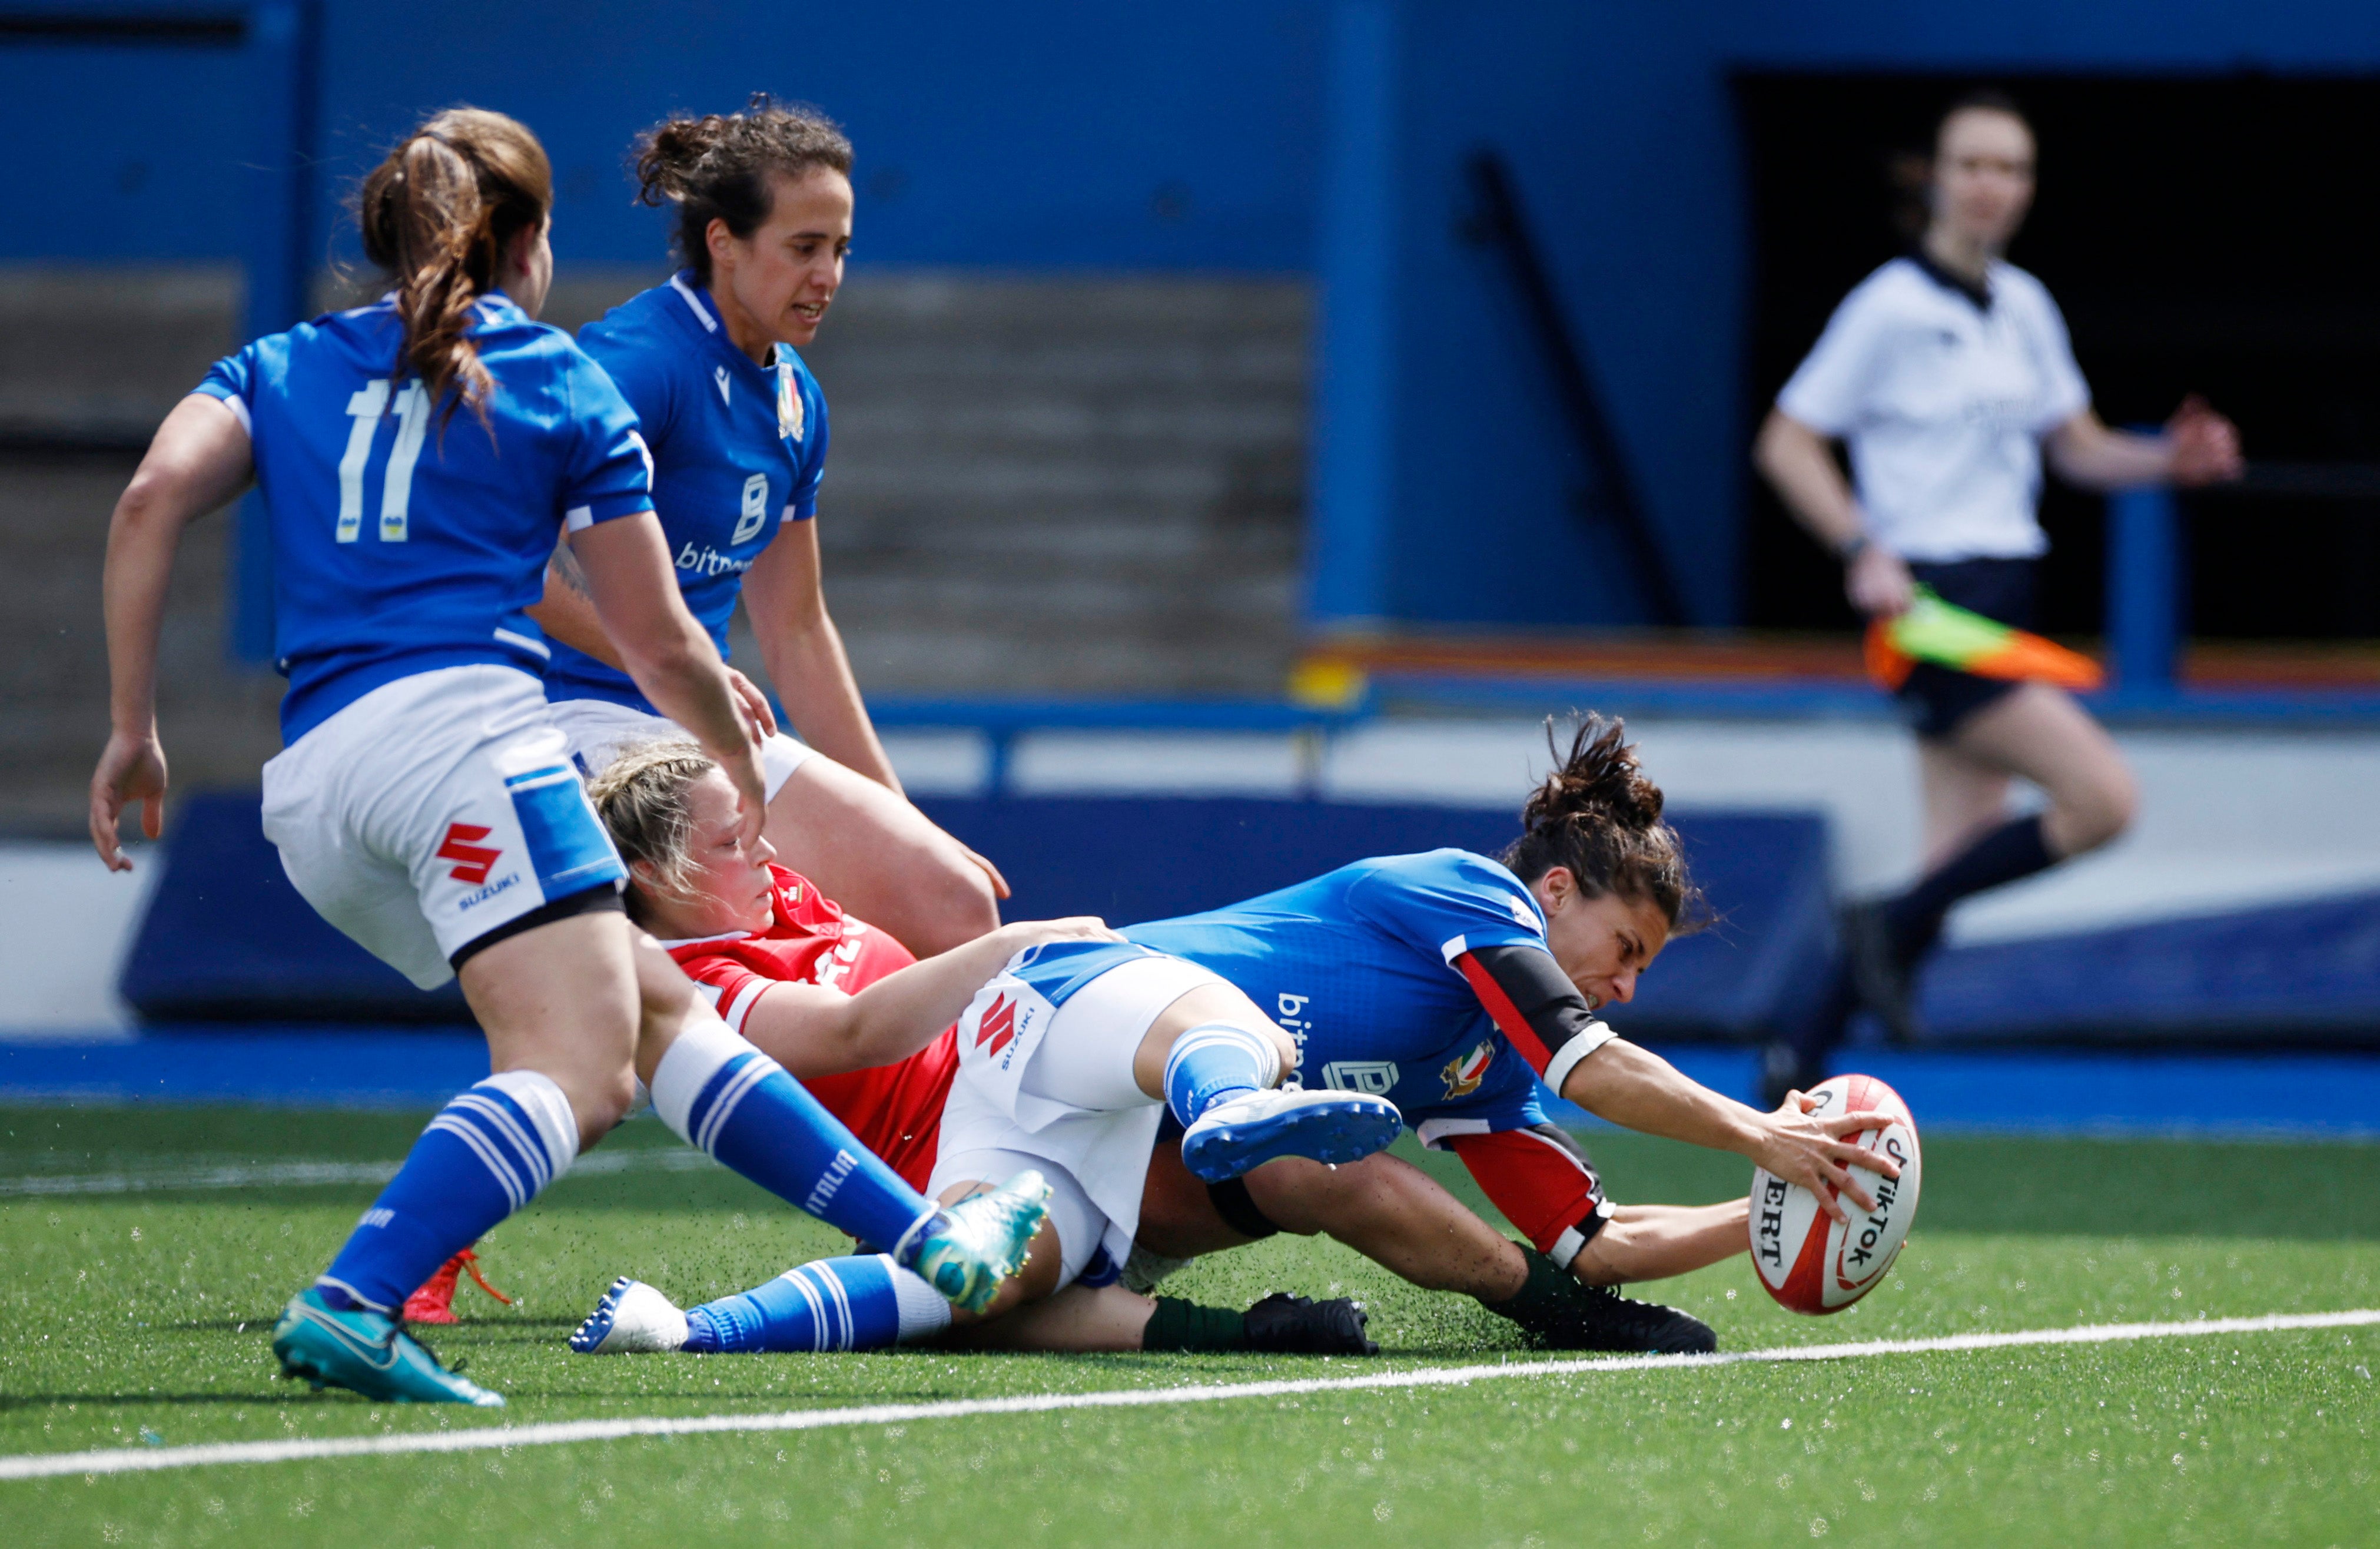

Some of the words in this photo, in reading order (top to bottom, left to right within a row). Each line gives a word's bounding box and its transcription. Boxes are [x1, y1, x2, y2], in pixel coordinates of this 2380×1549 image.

[335, 378, 431, 543] 11
[459, 872, 520, 911] SUZUKI
[1002, 1007, 1034, 1072] SUZUKI
[805, 1149, 858, 1215] ITALIA
